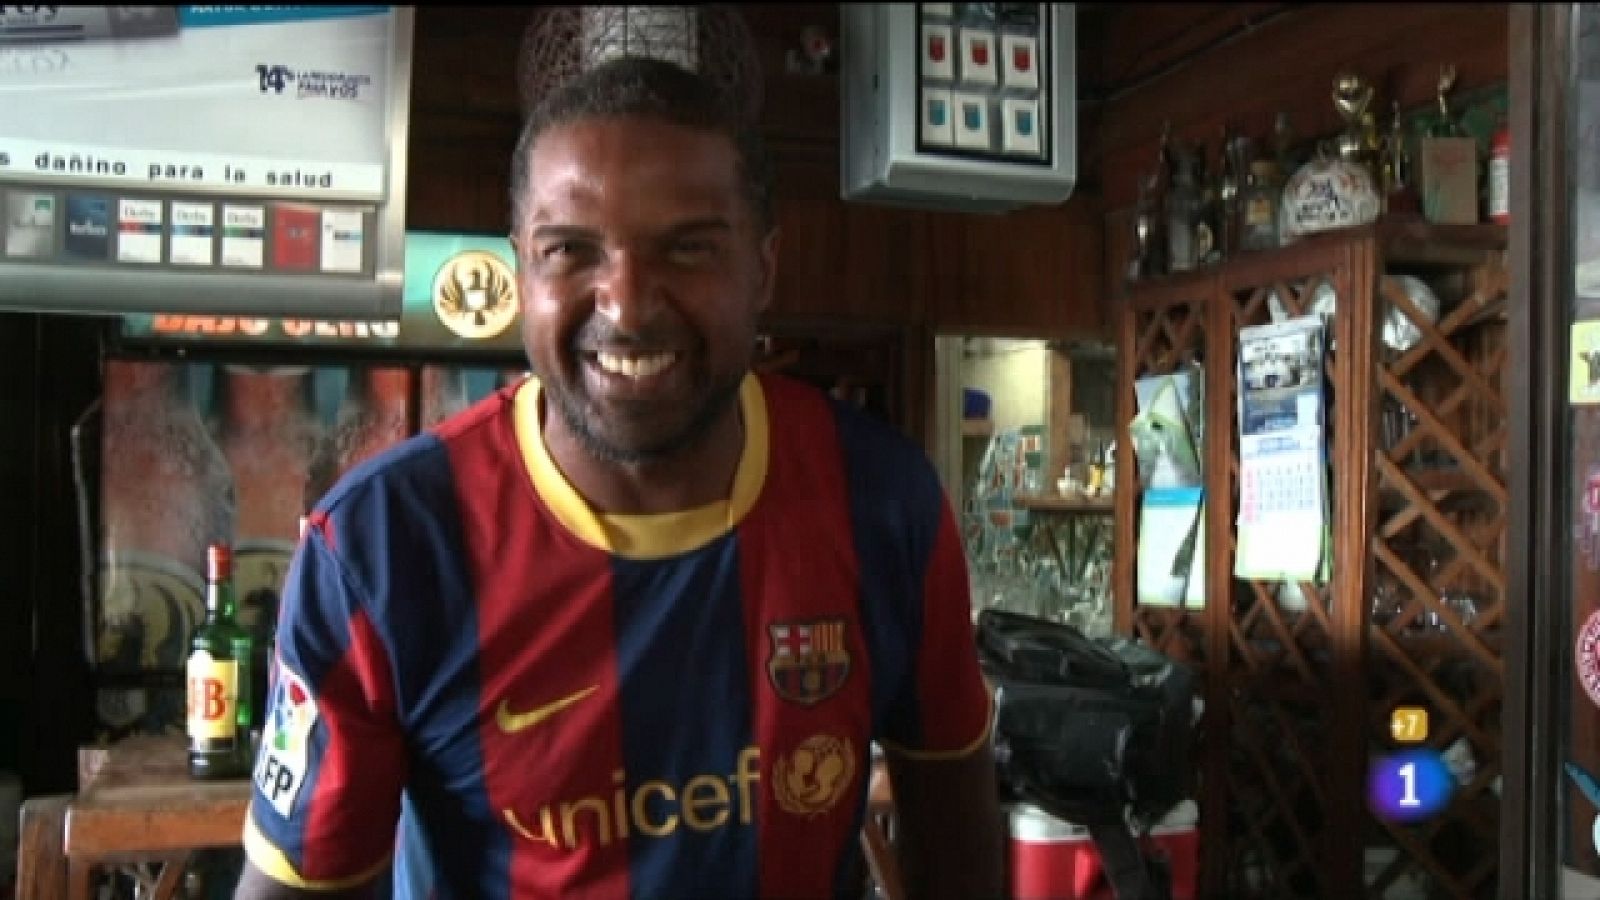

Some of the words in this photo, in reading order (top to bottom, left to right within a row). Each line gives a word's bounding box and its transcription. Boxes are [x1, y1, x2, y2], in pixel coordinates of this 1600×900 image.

[35, 152, 126, 176] dañino
[149, 163, 204, 182] para
[225, 164, 246, 183] la
[267, 169, 332, 189] salud
[502, 744, 761, 851] unicef
